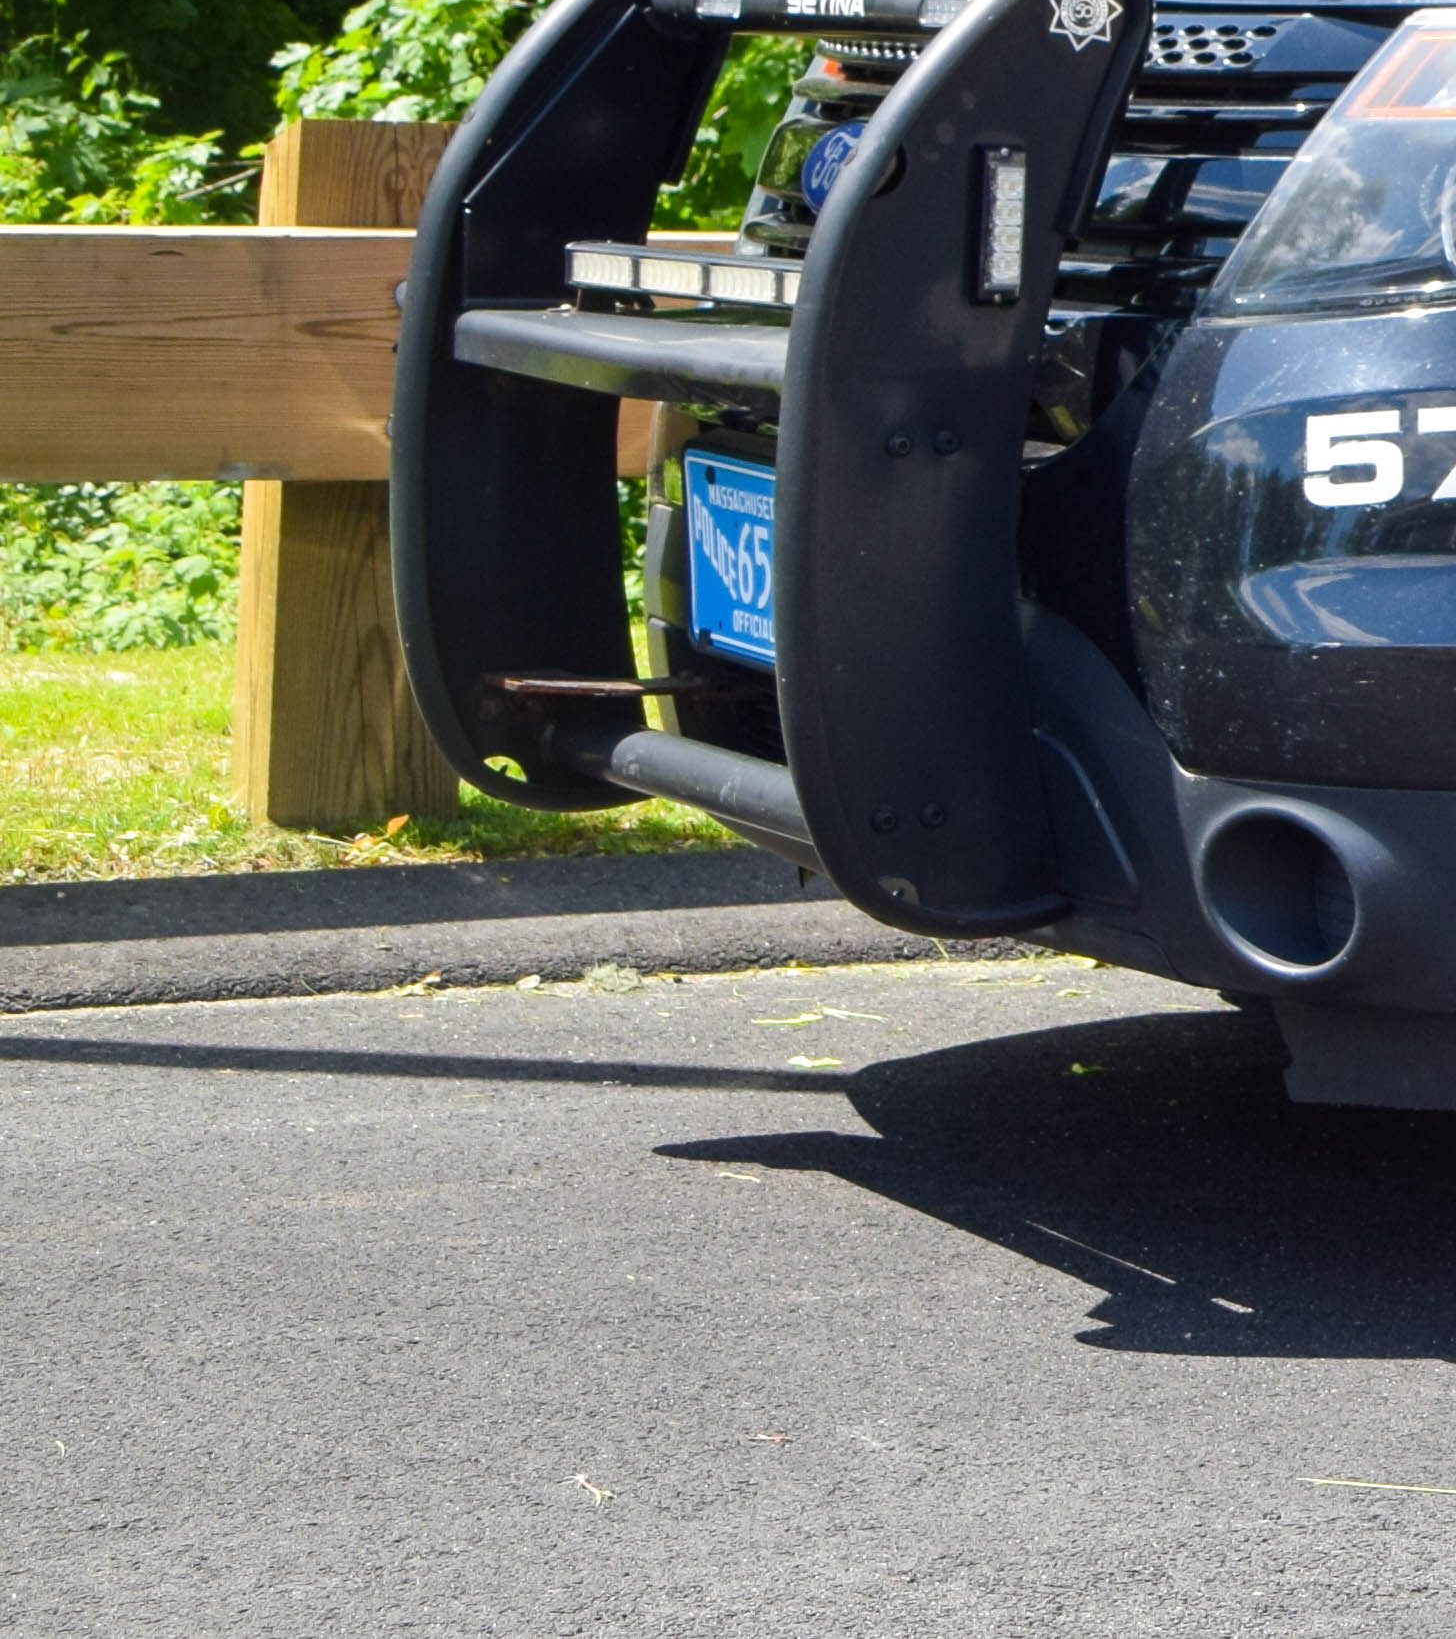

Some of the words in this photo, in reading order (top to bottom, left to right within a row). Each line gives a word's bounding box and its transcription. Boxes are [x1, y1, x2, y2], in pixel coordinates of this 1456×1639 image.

[708, 484, 776, 521] MASSACHUSET
[692, 493, 737, 602] POLICE
[737, 522, 772, 610] 65
